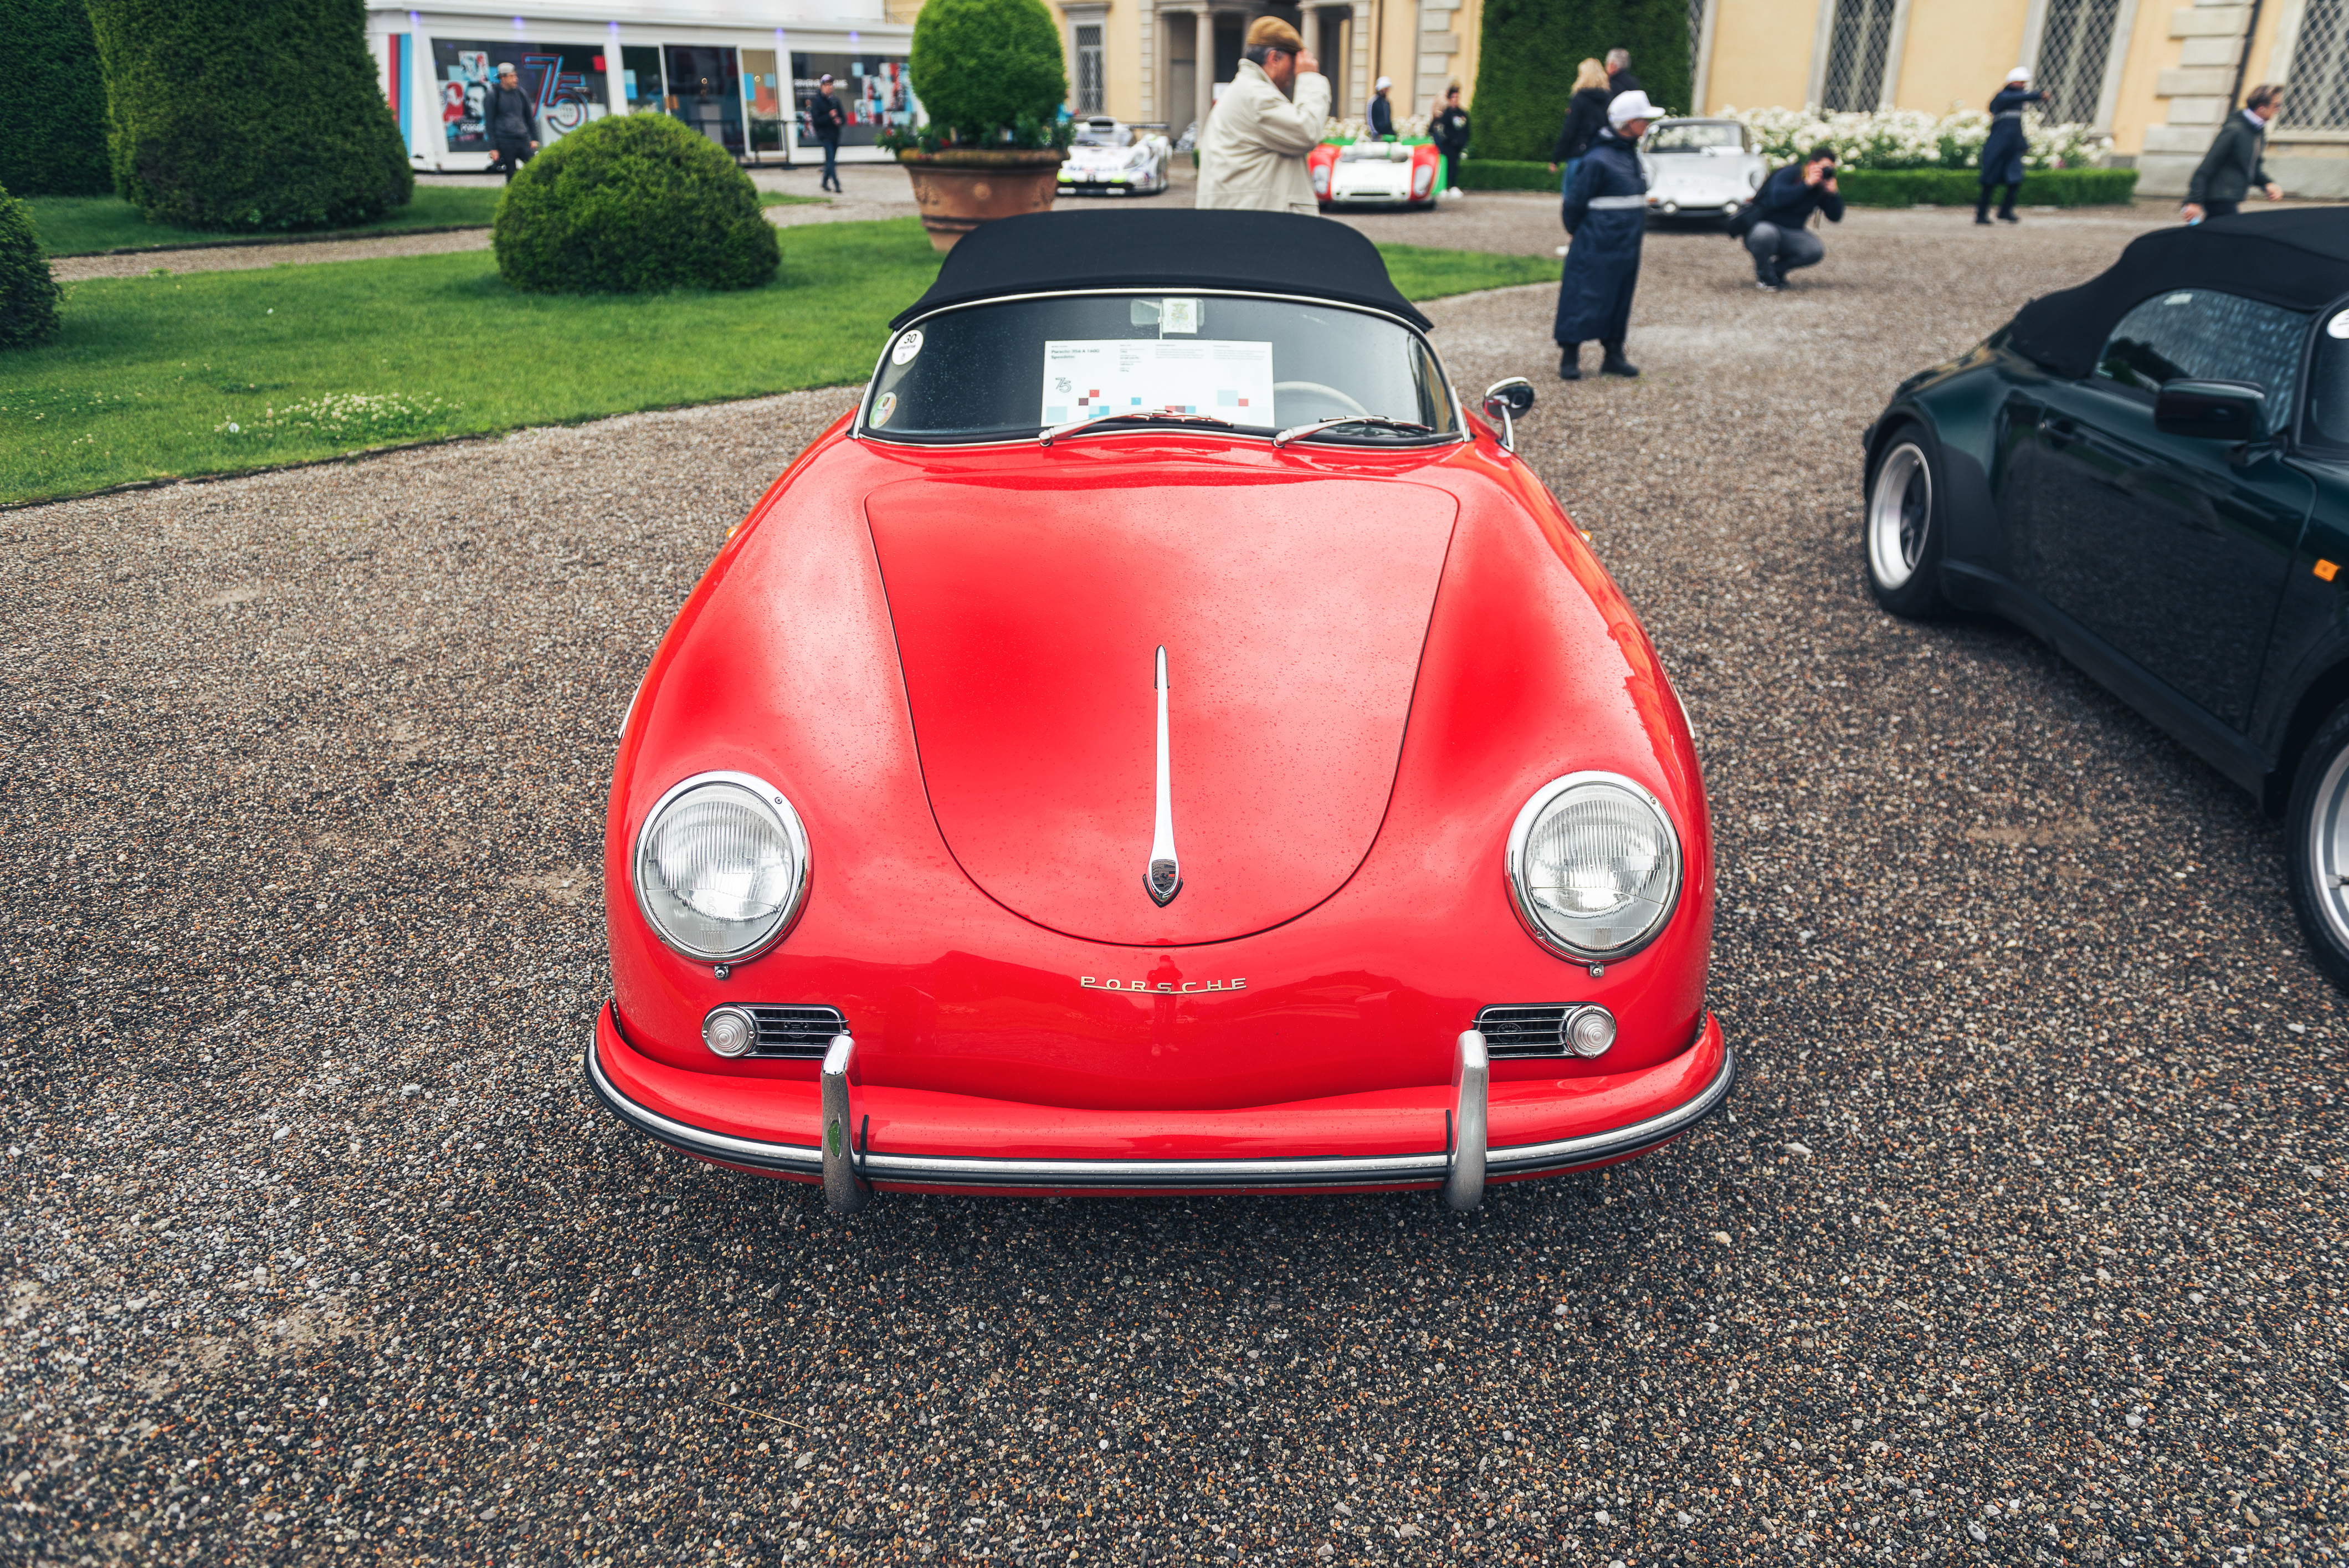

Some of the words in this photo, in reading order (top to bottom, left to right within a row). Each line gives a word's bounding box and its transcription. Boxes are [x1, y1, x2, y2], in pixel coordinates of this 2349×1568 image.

[521, 52, 589, 136] 75
[904, 334, 917, 344] 30
[1055, 377, 1071, 393] 75
[1080, 976, 1247, 995] PORSCHE
